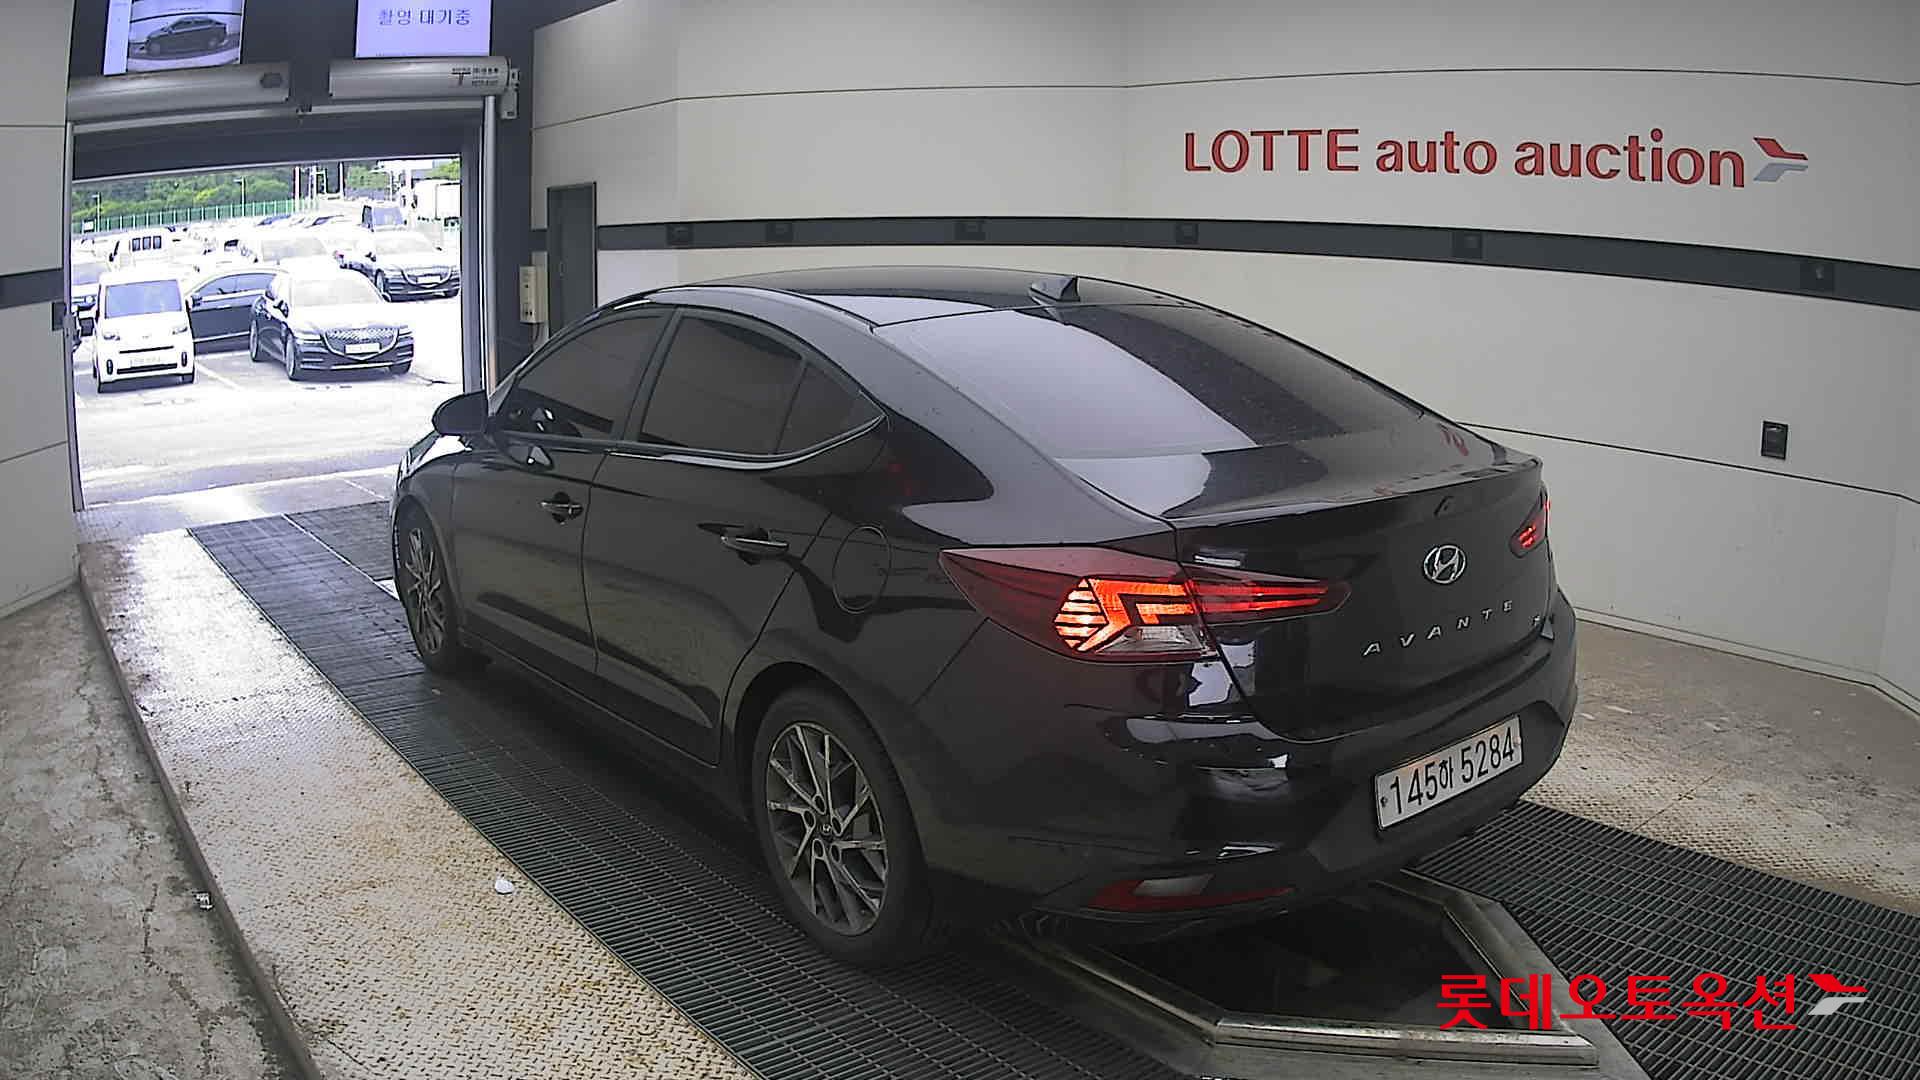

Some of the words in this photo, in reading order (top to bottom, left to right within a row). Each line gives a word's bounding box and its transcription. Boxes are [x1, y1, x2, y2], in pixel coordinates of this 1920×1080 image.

[419, 8, 471, 26] 대기중
[1185, 128, 1359, 172] LOTTE
[1376, 130, 1498, 174] auto
[1514, 128, 1745, 188] auction
[1362, 600, 1513, 656] AVANTE
[1390, 756, 1454, 815] 145하
[1460, 726, 1514, 784] 5284
